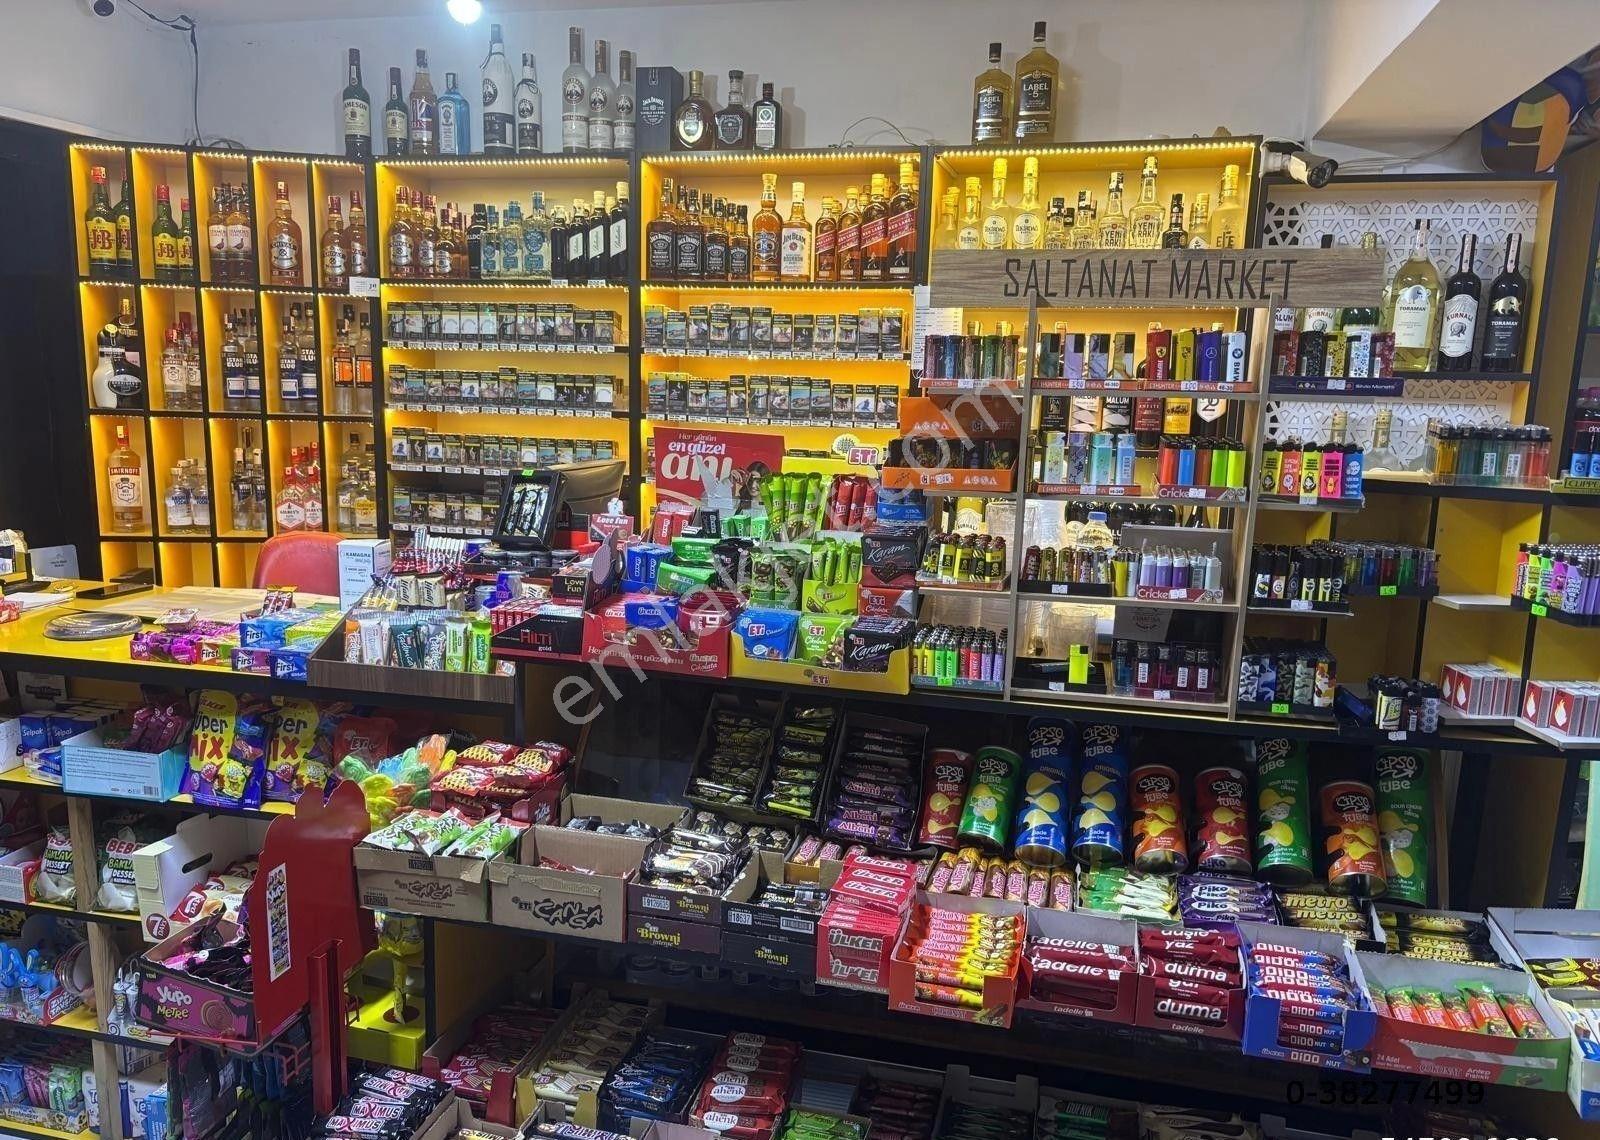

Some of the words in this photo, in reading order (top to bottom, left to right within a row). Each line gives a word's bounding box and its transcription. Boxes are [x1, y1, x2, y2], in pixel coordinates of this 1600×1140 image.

[1022, 82, 1049, 92] LABEL
[979, 96, 1000, 104] LABEL
[1004, 257, 1158, 299] SALTANAT
[1170, 258, 1298, 300] MARKET
[1445, 311, 1474, 322] KURNALI
[668, 441, 685, 450] en
[687, 440, 726, 456] güzel
[109, 467, 140, 476] SMIRNOFF
[1159, 487, 1190, 498] Cricke
[596, 516, 613, 524] Love
[1138, 588, 1169, 599] Cricke
[245, 630, 263, 641] First
[201, 648, 219, 659] First
[850, 642, 894, 661] Karam
[237, 655, 255, 666] First
[276, 661, 295, 673] First
[843, 881, 899, 899] ÜLKER
[1198, 885, 1228, 893] Piko
[1197, 901, 1228, 910] Piko
[1285, 895, 1349, 909] metro
[532, 898, 603, 930] CANGA
[1296, 908, 1359, 921] metro
[149, 916, 163, 937] 7
[636, 928, 682, 946] Browni
[829, 928, 883, 951] ÜLKER
[754, 949, 790, 966] Browni
[829, 958, 880, 983] ÜLKER
[1031, 956, 1105, 977] tadelle
[1164, 961, 1228, 982] durma
[1264, 965, 1308, 981] DIDO
[1054, 1006, 1084, 1016] tadelle
[1156, 999, 1223, 1022] durma
[1290, 1006, 1315, 1018] DIDO
[1171, 1023, 1204, 1034] tadelle
[1298, 1023, 1324, 1035] DIDO
[1289, 1036, 1315, 1048] DIDO
[1289, 1052, 1321, 1064] DIDO
[1325, 1060, 1342, 1069] NUT
[715, 1075, 748, 1086] ahenk
[713, 1086, 745, 1097] ahenk
[352, 1103, 404, 1119] MAXIMUS
[328, 1116, 385, 1132] MAXIMUS
[706, 1113, 737, 1126] ahenk
